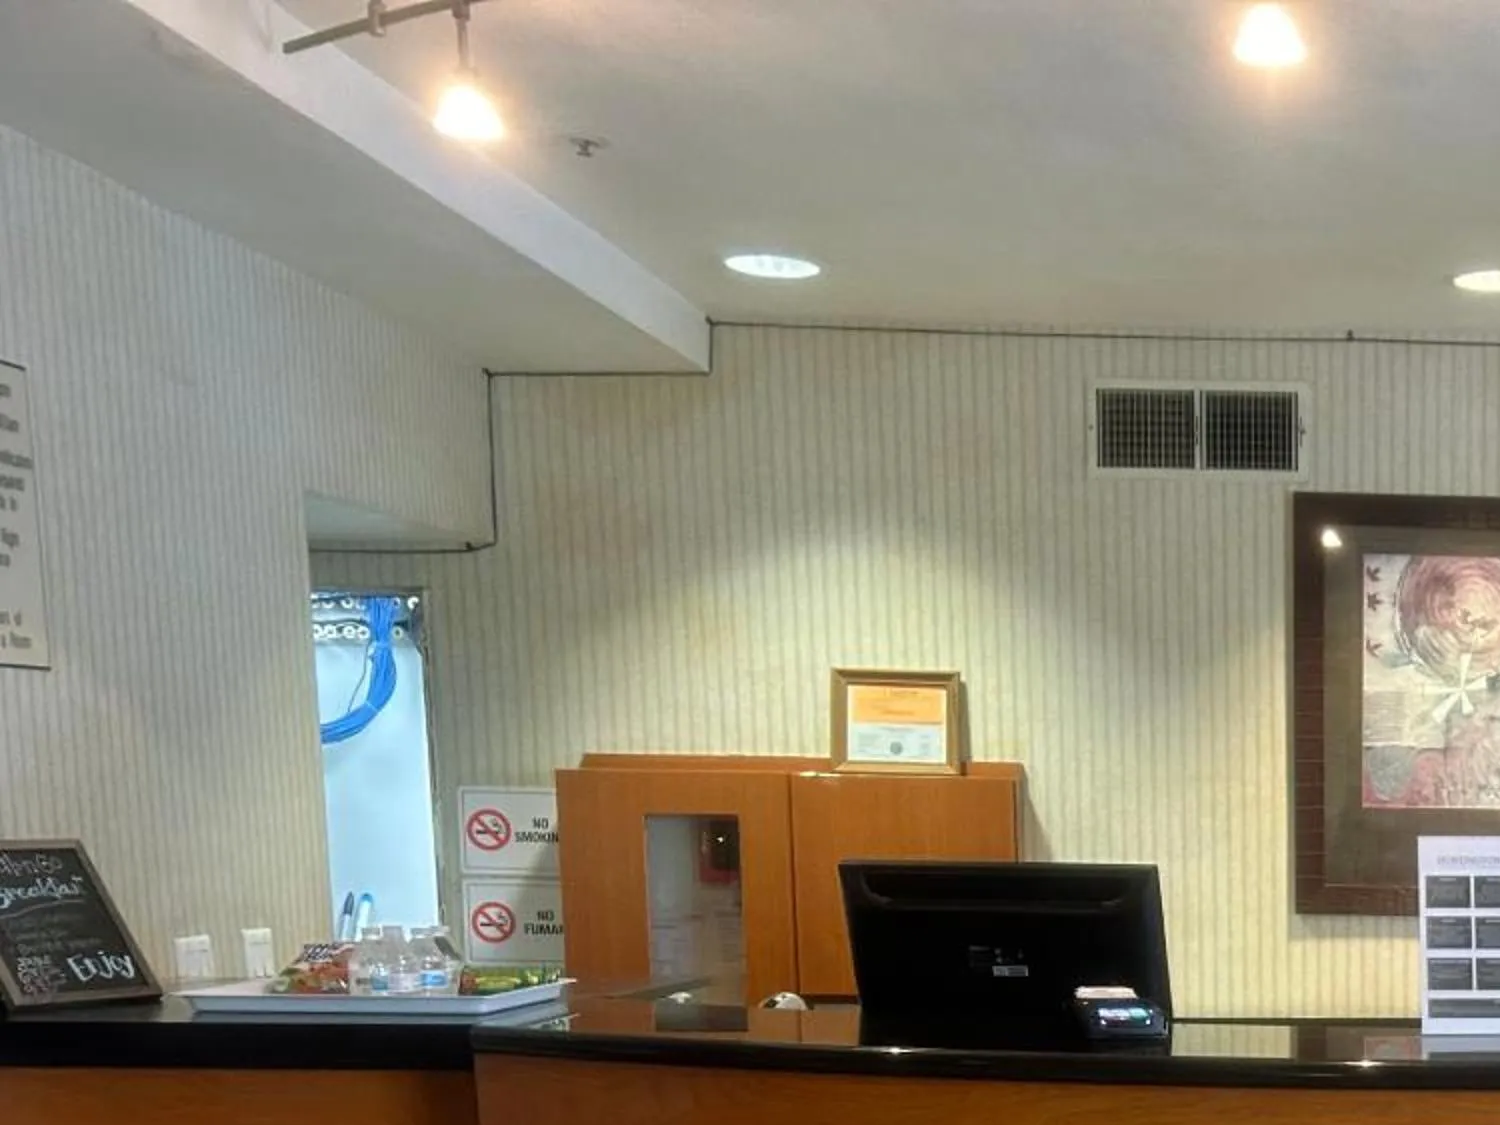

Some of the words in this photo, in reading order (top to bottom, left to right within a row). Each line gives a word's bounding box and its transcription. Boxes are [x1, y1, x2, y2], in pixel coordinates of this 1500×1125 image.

[532, 816, 549, 829] NO
[515, 831, 559, 843] SMOKIN
[537, 911, 555, 921] NO
[66, 951, 135, 982] Enjoy
